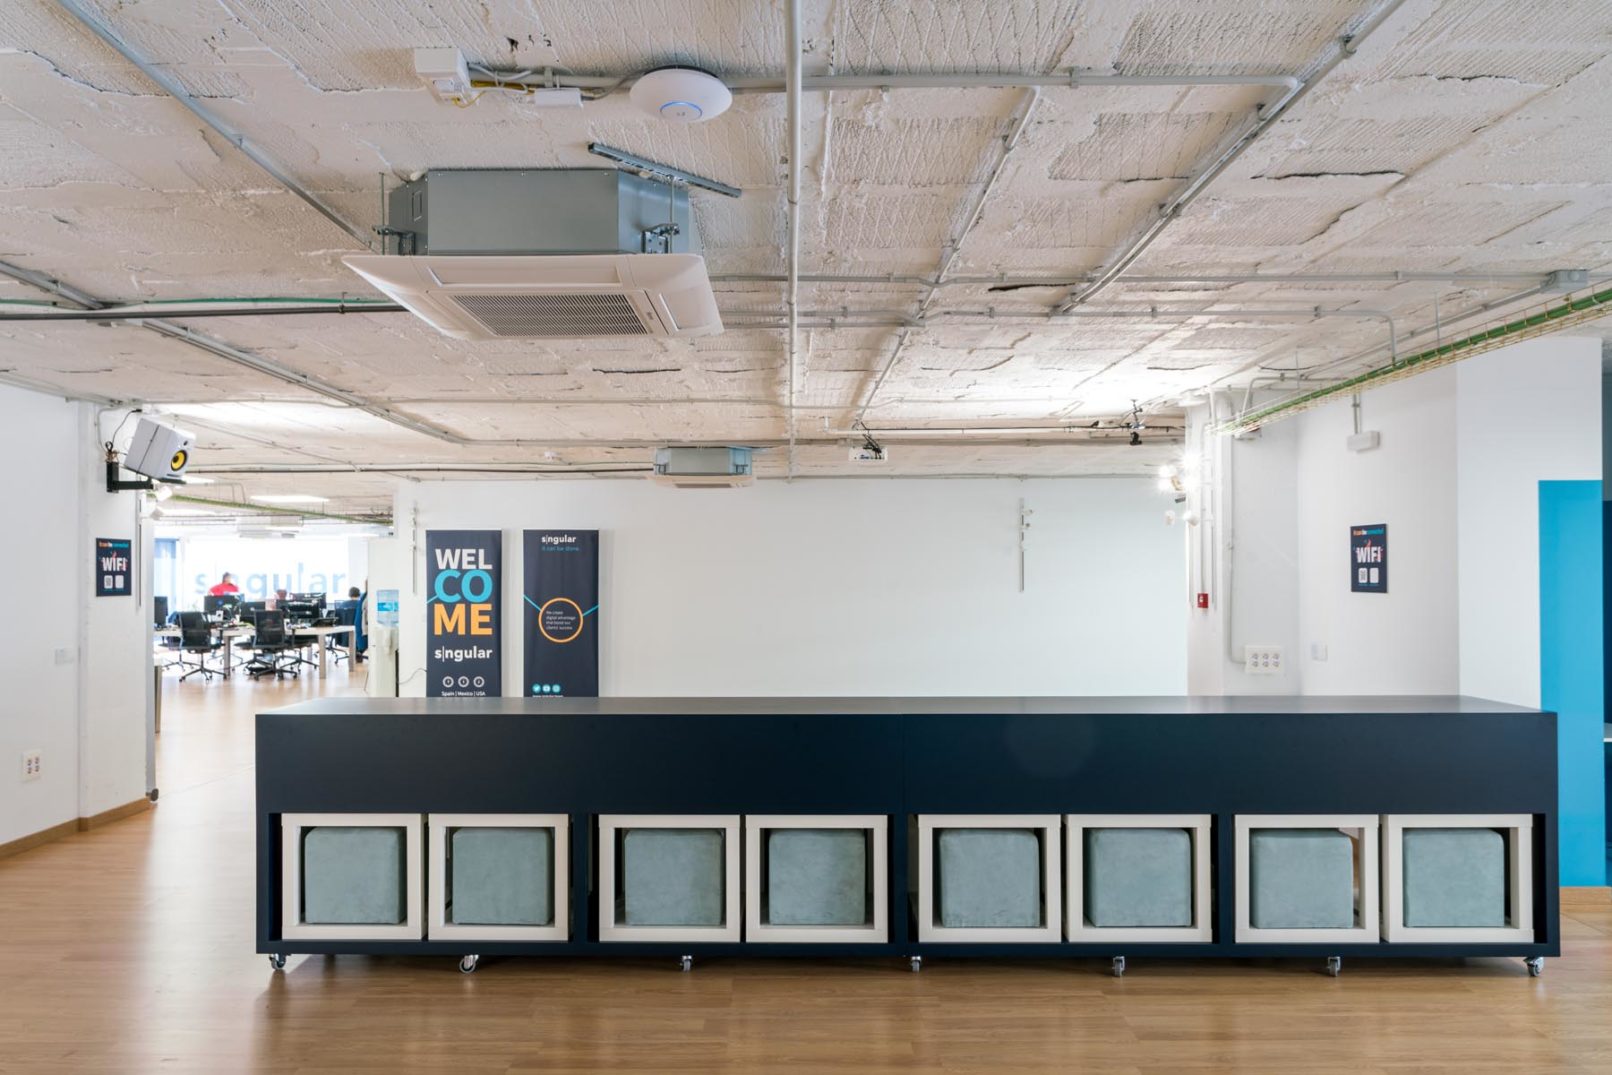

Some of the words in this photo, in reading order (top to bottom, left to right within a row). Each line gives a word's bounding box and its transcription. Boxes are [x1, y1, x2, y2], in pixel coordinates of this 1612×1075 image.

[102, 557, 127, 572] WIFI
[435, 549, 493, 570] WEL
[1356, 546, 1382, 563] WIFI
[195, 562, 346, 603] sgular
[434, 569, 493, 603] CO
[434, 603, 493, 635] ME
